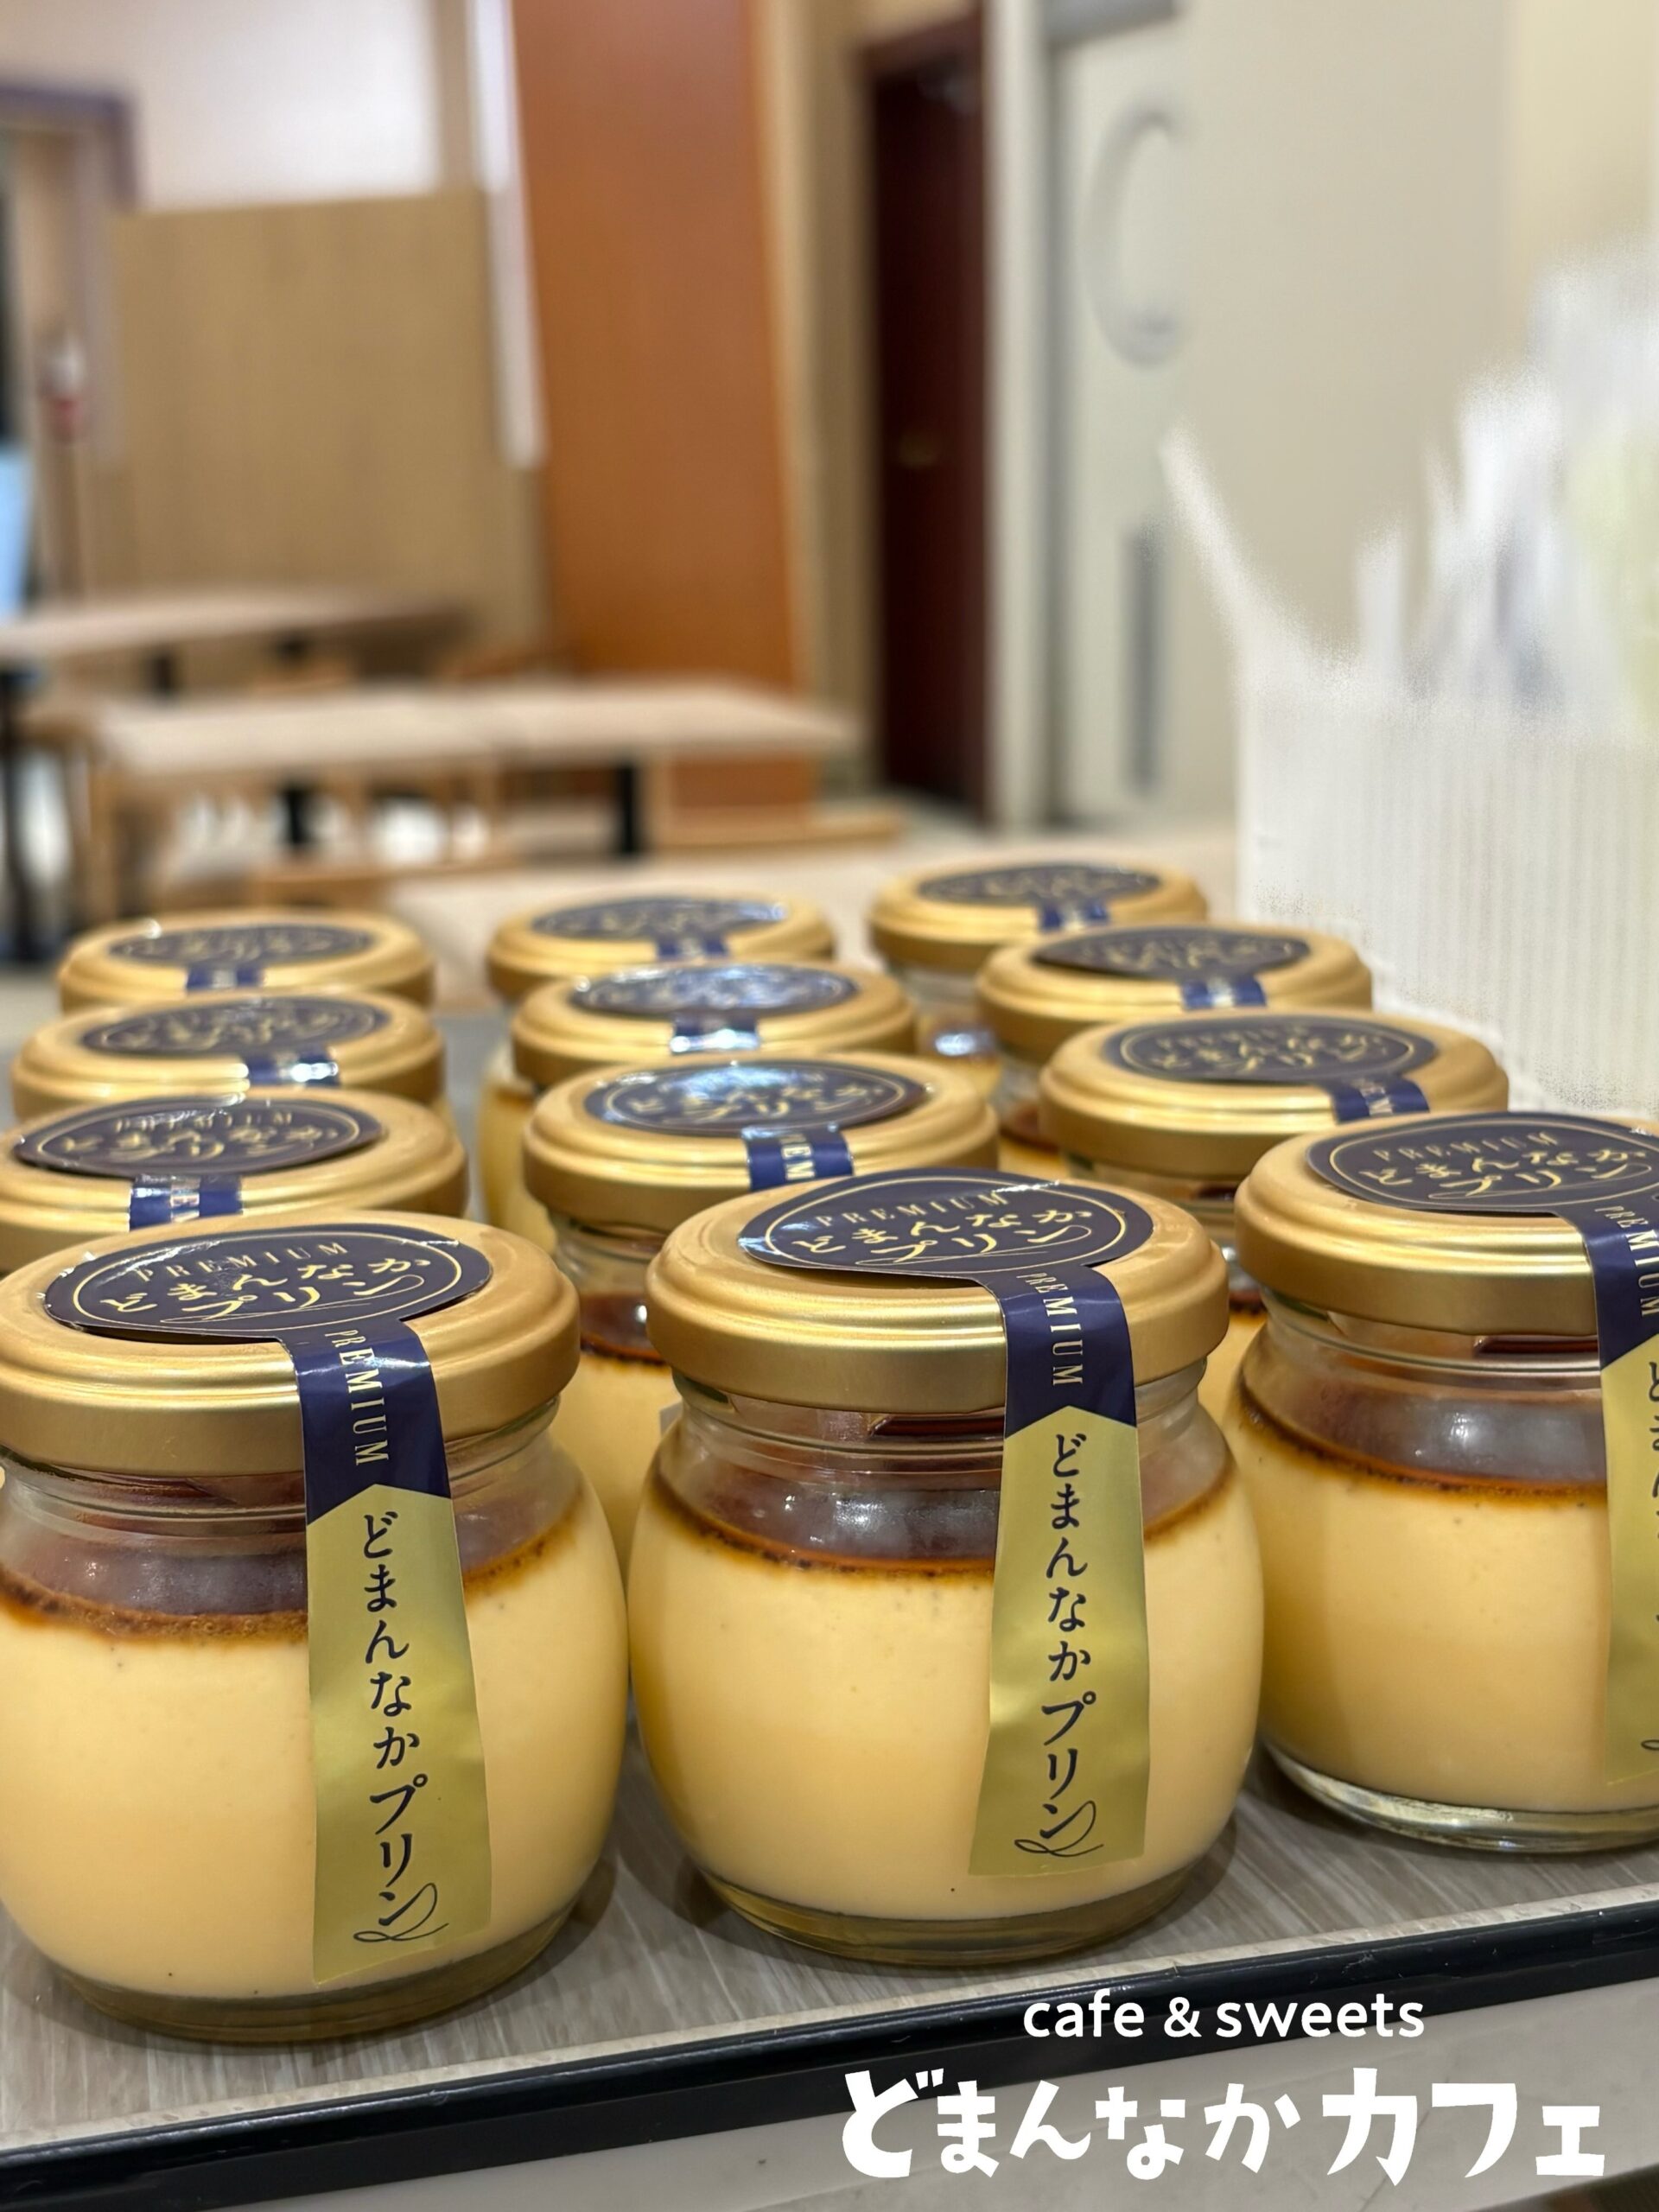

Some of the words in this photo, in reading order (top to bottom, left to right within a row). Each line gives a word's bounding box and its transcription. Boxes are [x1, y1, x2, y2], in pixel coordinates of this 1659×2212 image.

[791, 1209, 1093, 1254] どまんなか
[815, 1189, 1011, 1228] PREMIUM
[133, 1242, 350, 1283] PREMIUM
[855, 1224, 1092, 1267] プリン
[99, 1257, 432, 1313] どまんなか
[160, 1274, 425, 1324] プリン
[1016, 1272, 1084, 1387] PREMIUM
[324, 1329, 389, 1466] PREMIUM
[1014, 1433, 1104, 1858] どまんなかプリン
[353, 1510, 449, 1943] どまんなかプリン
